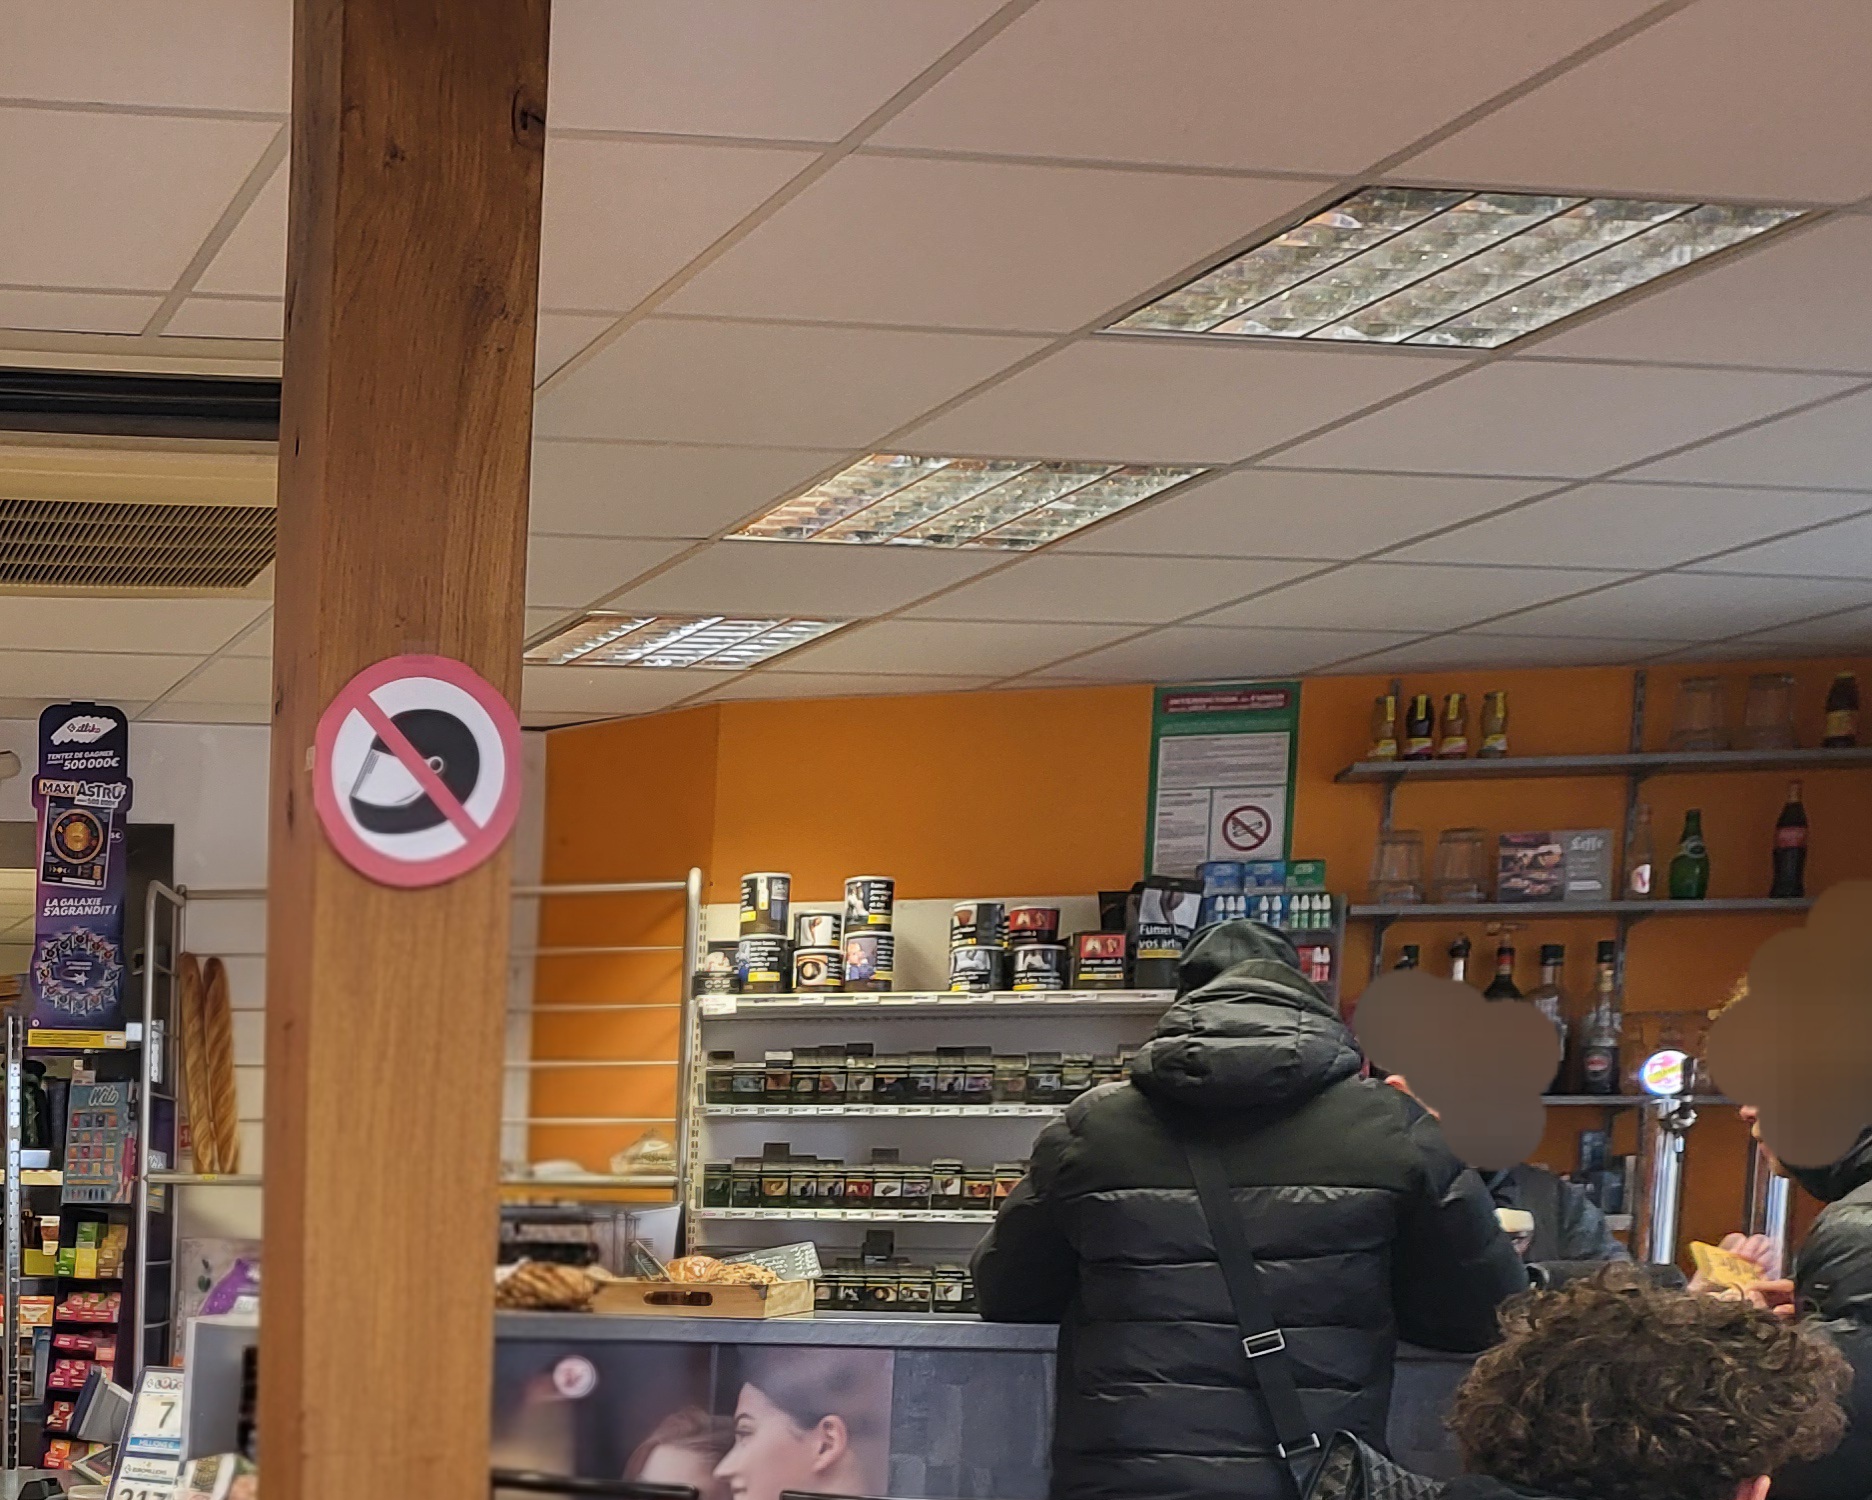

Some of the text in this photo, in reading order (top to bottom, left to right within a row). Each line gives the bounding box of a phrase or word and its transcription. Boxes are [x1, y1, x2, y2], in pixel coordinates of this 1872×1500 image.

[47, 752, 74, 760] TENTEZ
[84, 750, 114, 758] GAGNER
[42, 782, 74, 795] MAXI
[45, 897, 102, 907] LA GALAXIE
[43, 905, 113, 916] S'AGRANDIT
[1138, 939, 1159, 949] vos
[160, 1402, 175, 1429] 7
